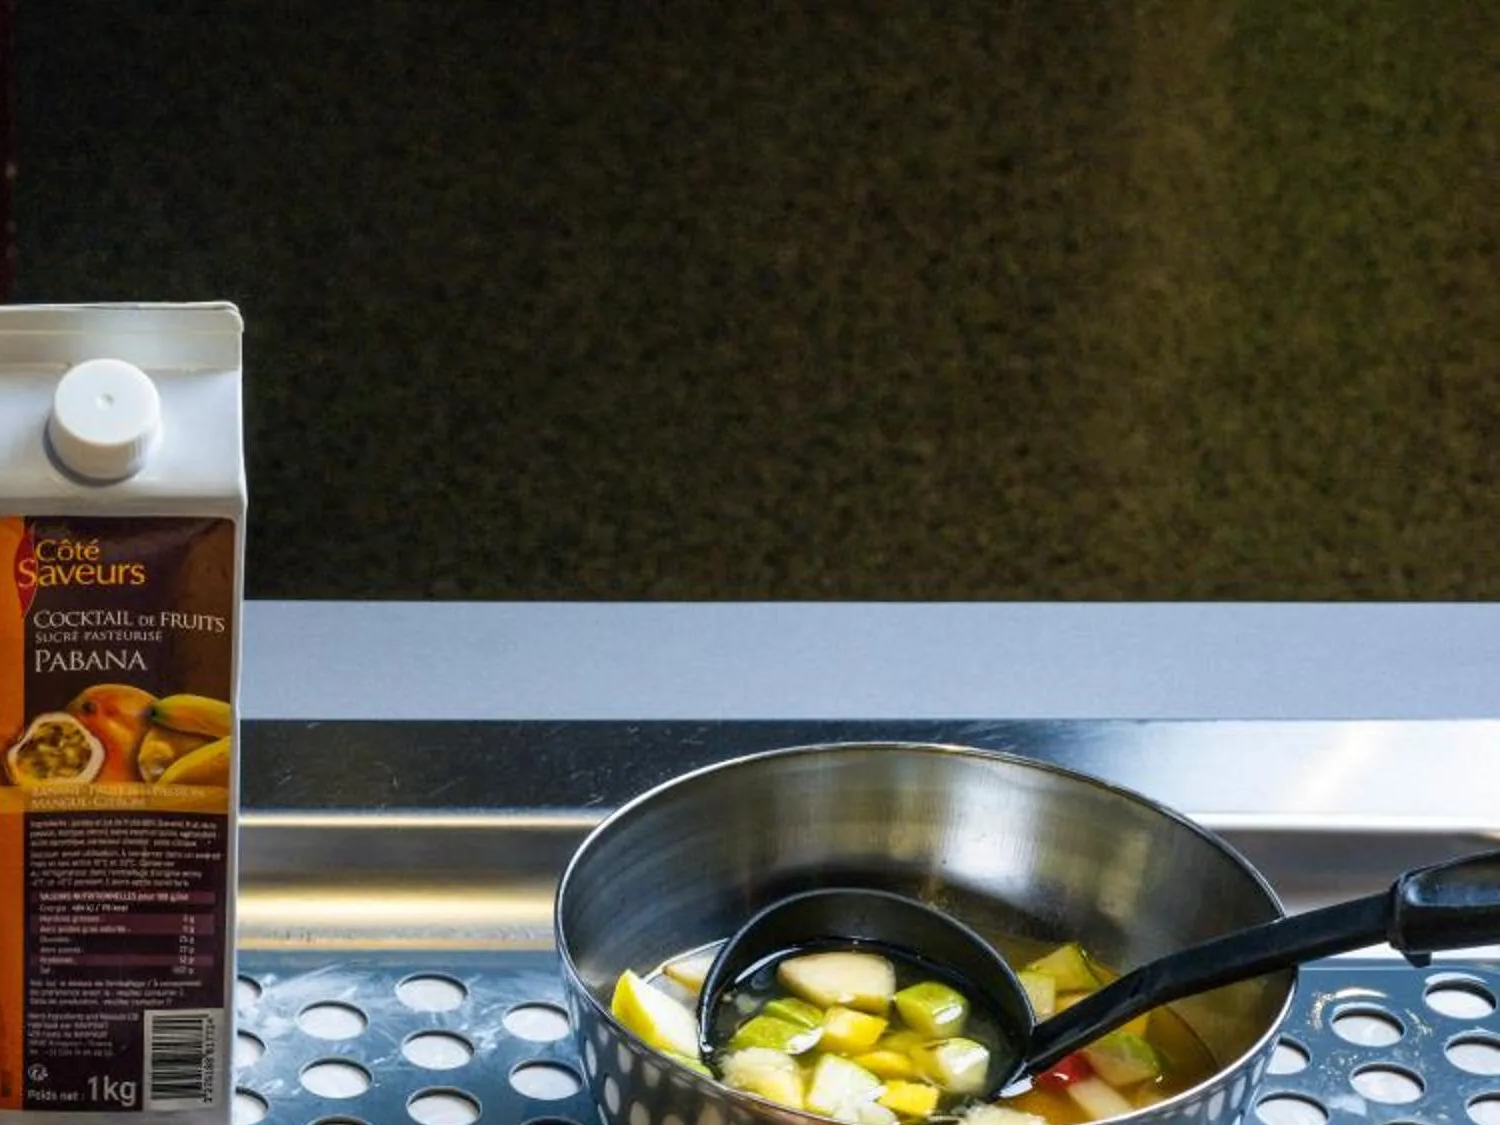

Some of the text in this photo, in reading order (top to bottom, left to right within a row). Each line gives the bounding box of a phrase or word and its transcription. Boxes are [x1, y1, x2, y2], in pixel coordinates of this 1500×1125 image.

[35, 538, 100, 562] Côté
[17, 558, 147, 589] Saveurs
[33, 608, 133, 629] COCKTAIL
[159, 611, 226, 634] FRUITS
[34, 649, 148, 673] PABANA
[86, 1075, 138, 1106] 1kg
